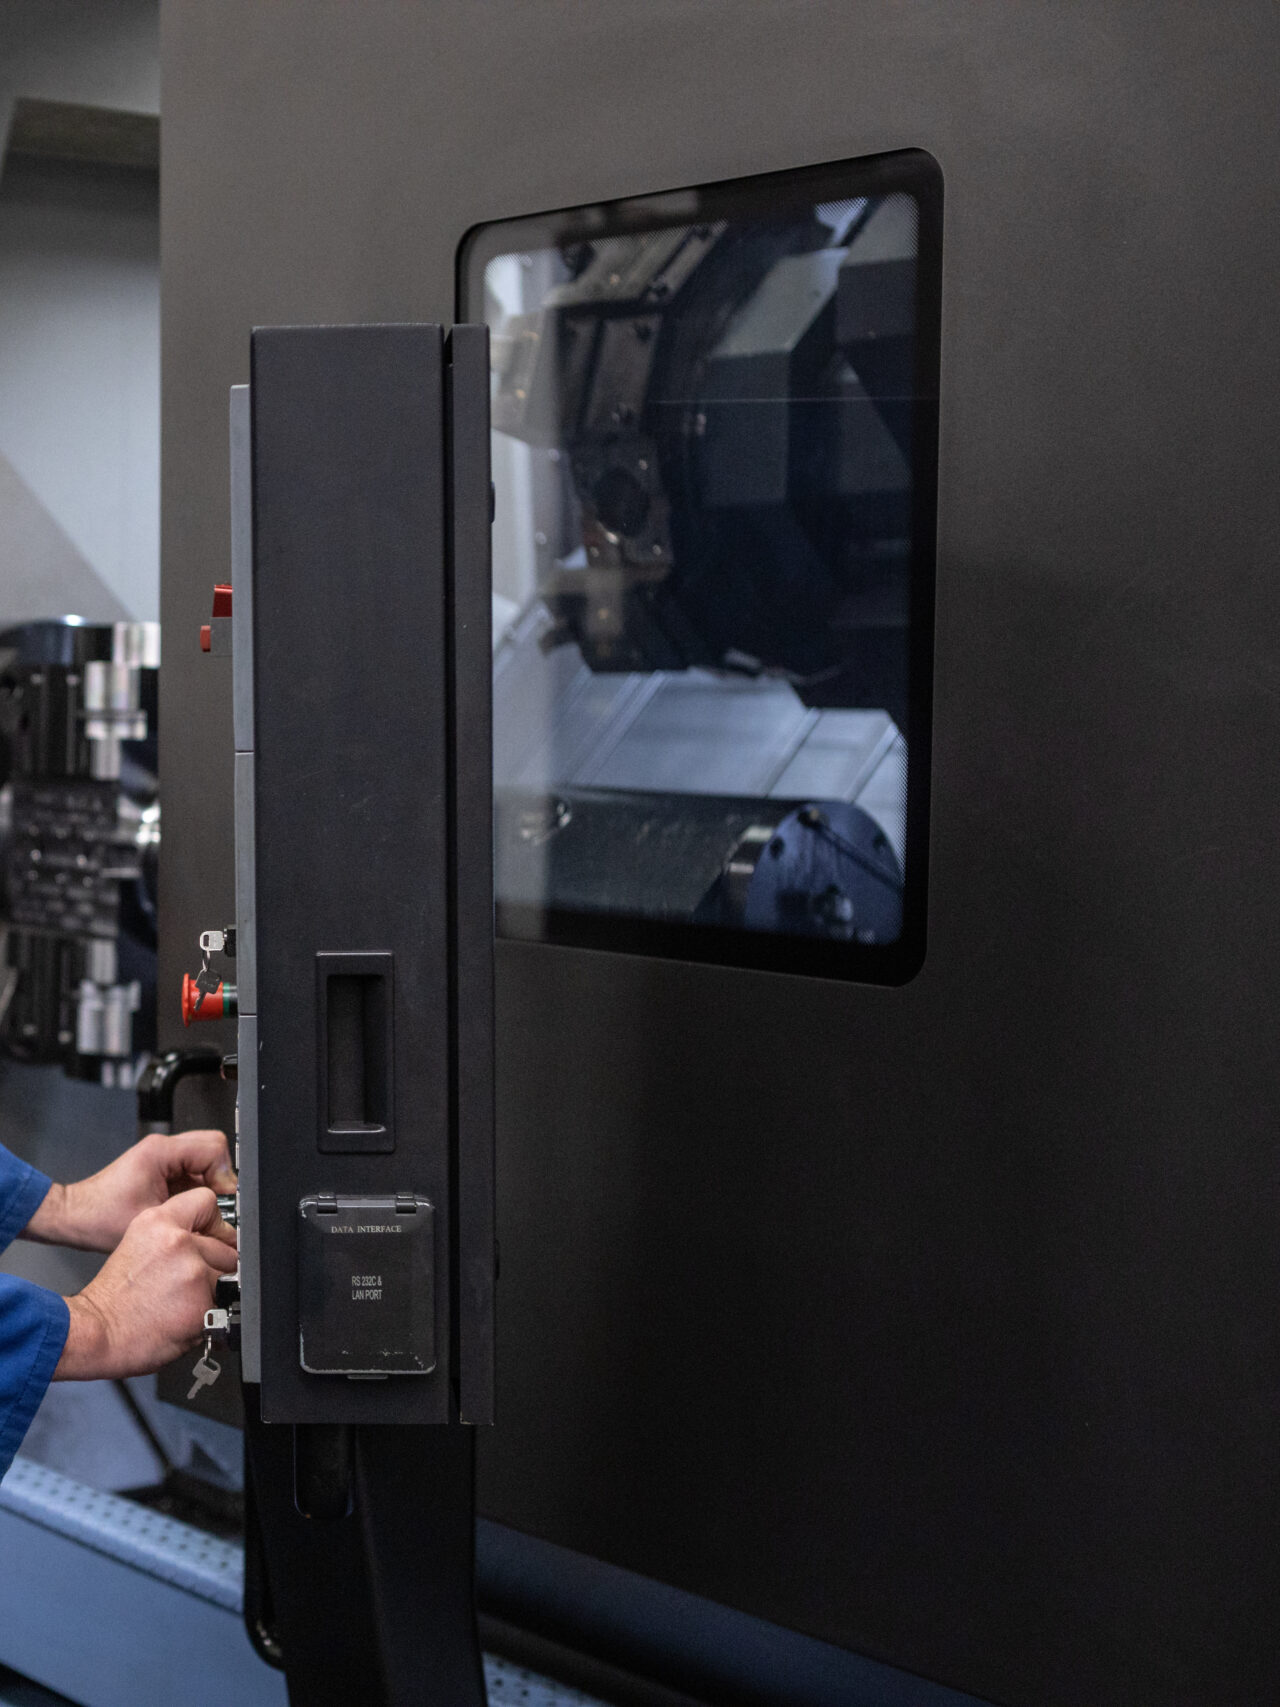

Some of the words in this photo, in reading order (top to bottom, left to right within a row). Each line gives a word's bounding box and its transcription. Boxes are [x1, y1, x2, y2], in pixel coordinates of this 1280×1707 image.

[331, 1225, 354, 1234] DATA
[357, 1224, 402, 1233] INTERFACE
[351, 1275, 361, 1287] RS
[361, 1275, 376, 1287] 232C
[351, 1289, 364, 1300] LAN
[365, 1289, 383, 1300] PORT
